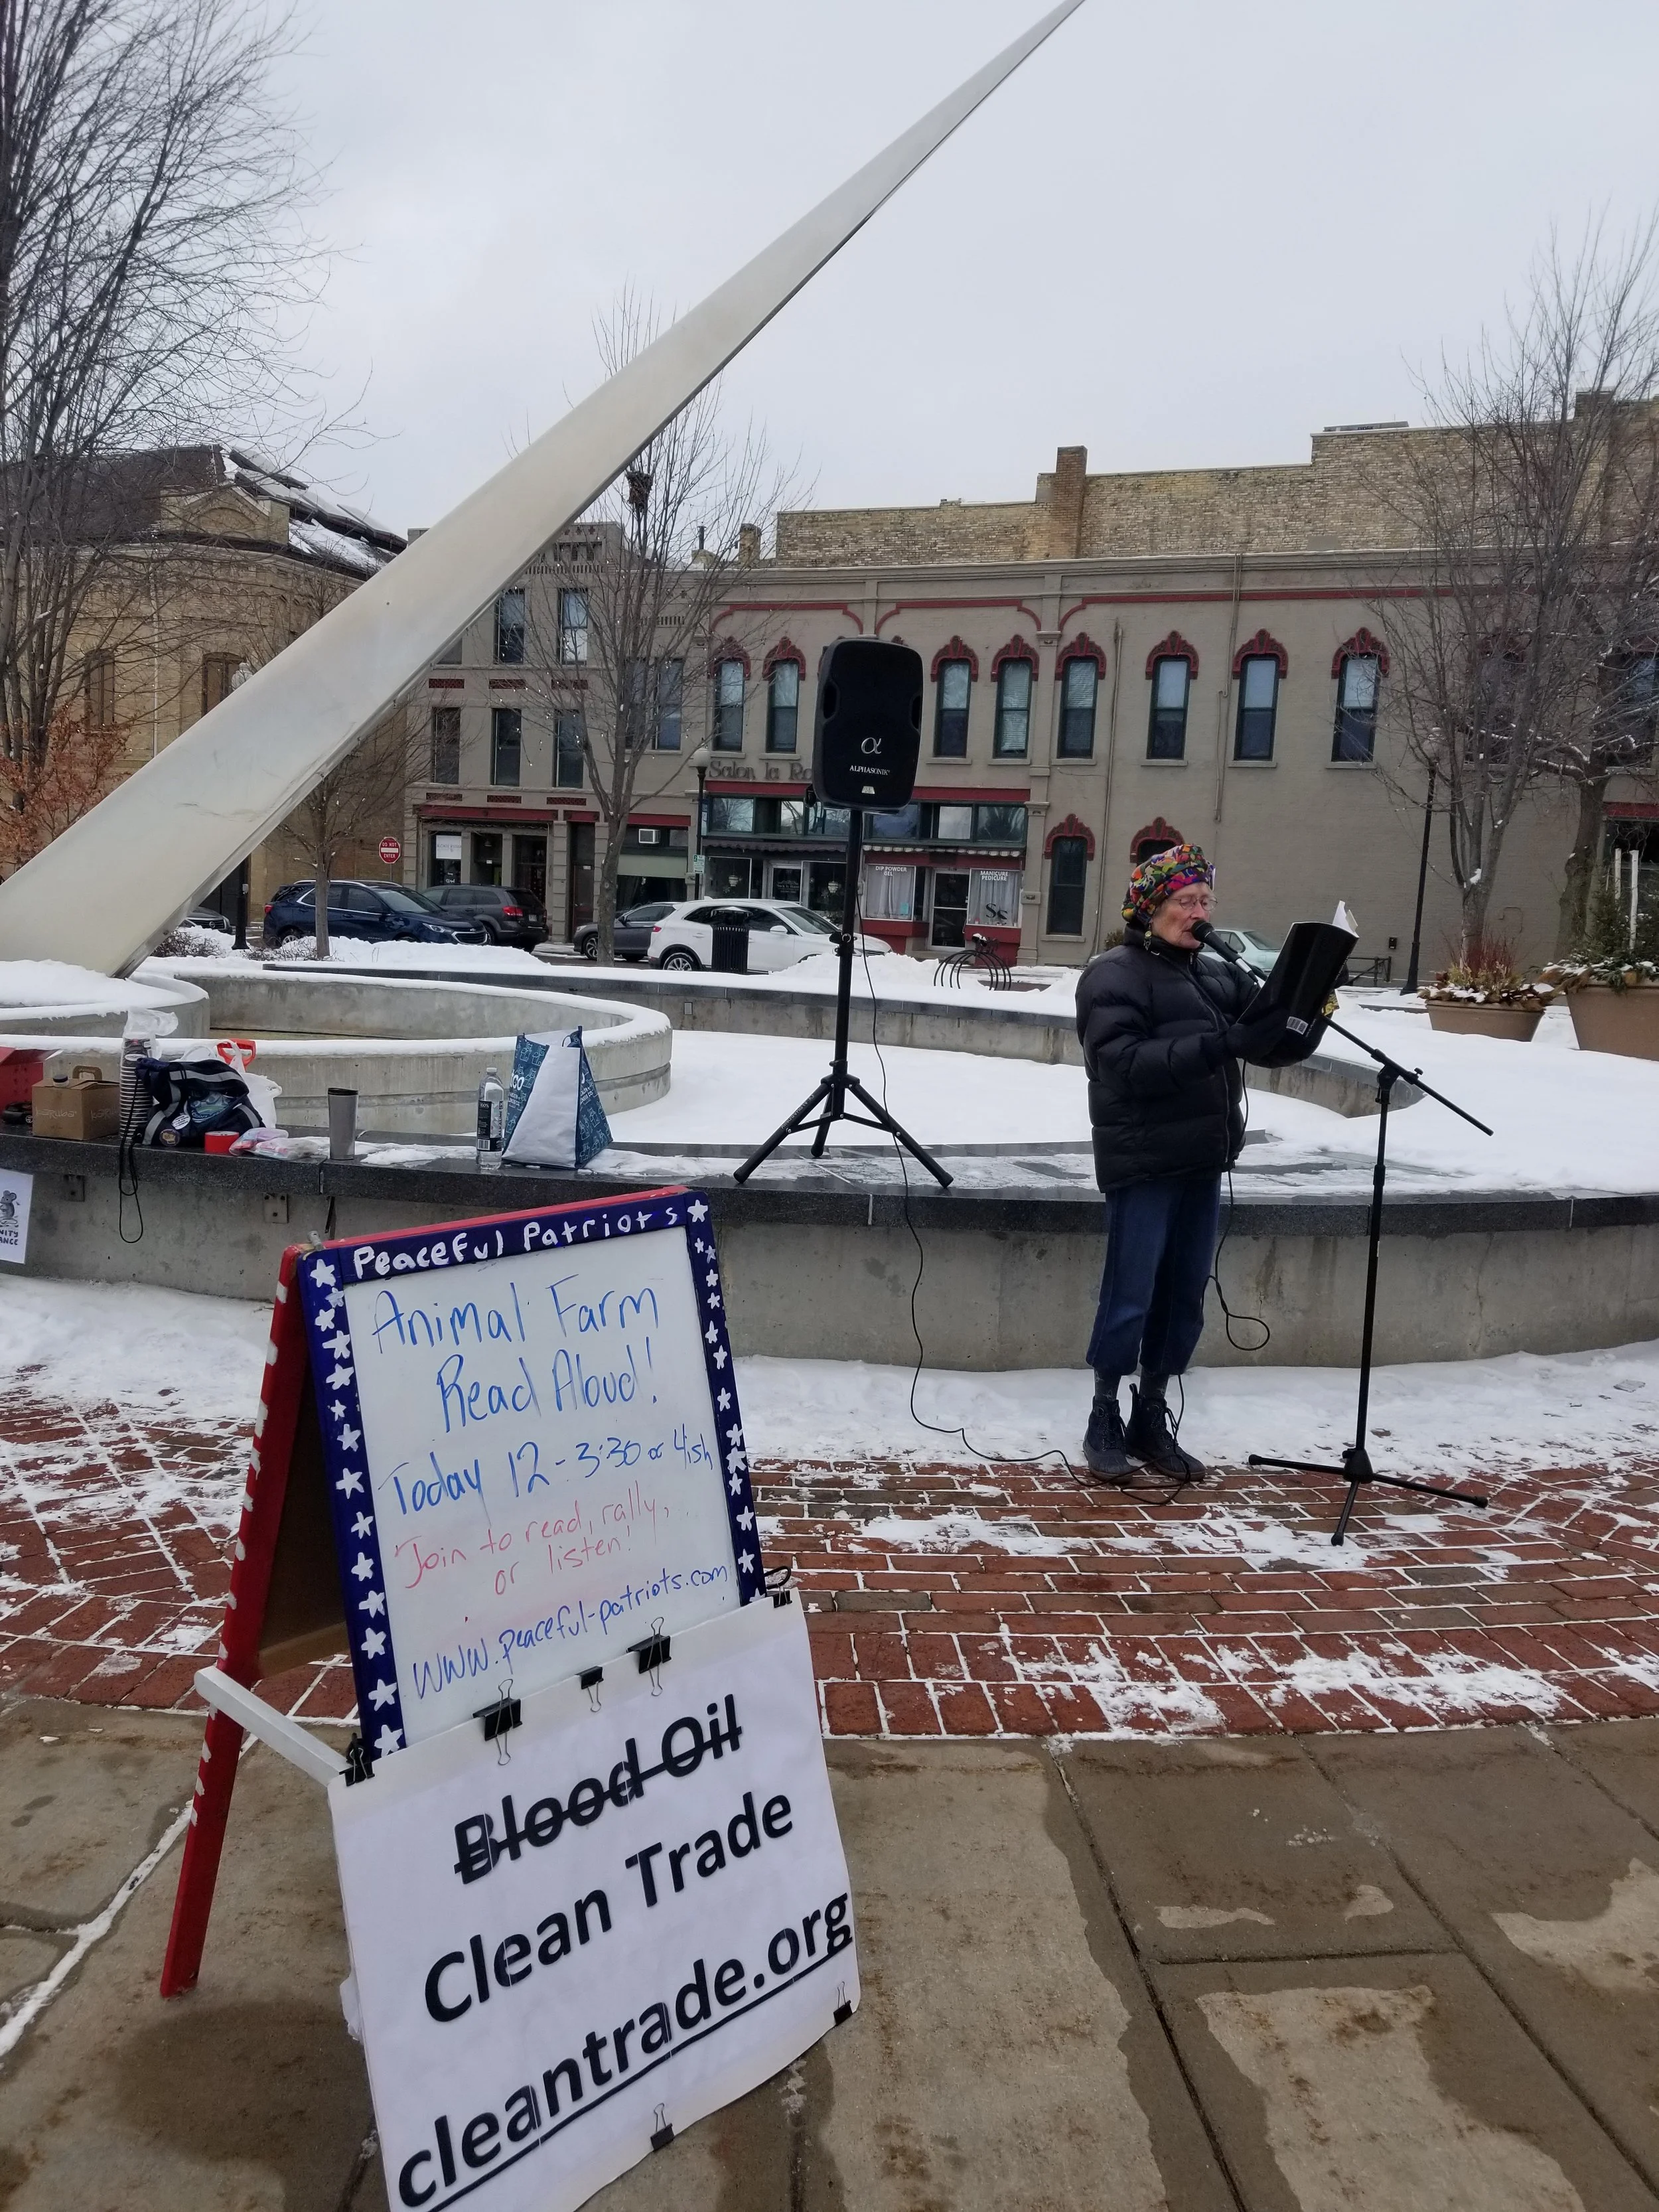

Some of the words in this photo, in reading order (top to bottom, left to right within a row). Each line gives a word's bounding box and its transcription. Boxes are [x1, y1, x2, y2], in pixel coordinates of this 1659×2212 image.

[709, 760, 756, 780] Salon
[765, 762, 780, 780] la
[353, 1230, 503, 1279] Peaceful
[524, 1207, 678, 1251] Patriots
[372, 1282, 525, 1354] Animal
[545, 1274, 658, 1338] Farm
[436, 1354, 541, 1433] Read
[551, 1336, 657, 1412] Aloud!
[378, 1451, 491, 1526] Today
[394, 1535, 467, 1589] Join
[480, 1528, 512, 1555] to
[526, 1501, 594, 1542] read,
[495, 1562, 520, 1595] or
[547, 1525, 631, 1574] listen!
[455, 1737, 644, 1885] Blood
[662, 1694, 742, 1777] Oil
[424, 1889, 611, 2023] Clean
[625, 1791, 793, 1907] Trade
[398, 1892, 853, 2207] cleantrade.org
